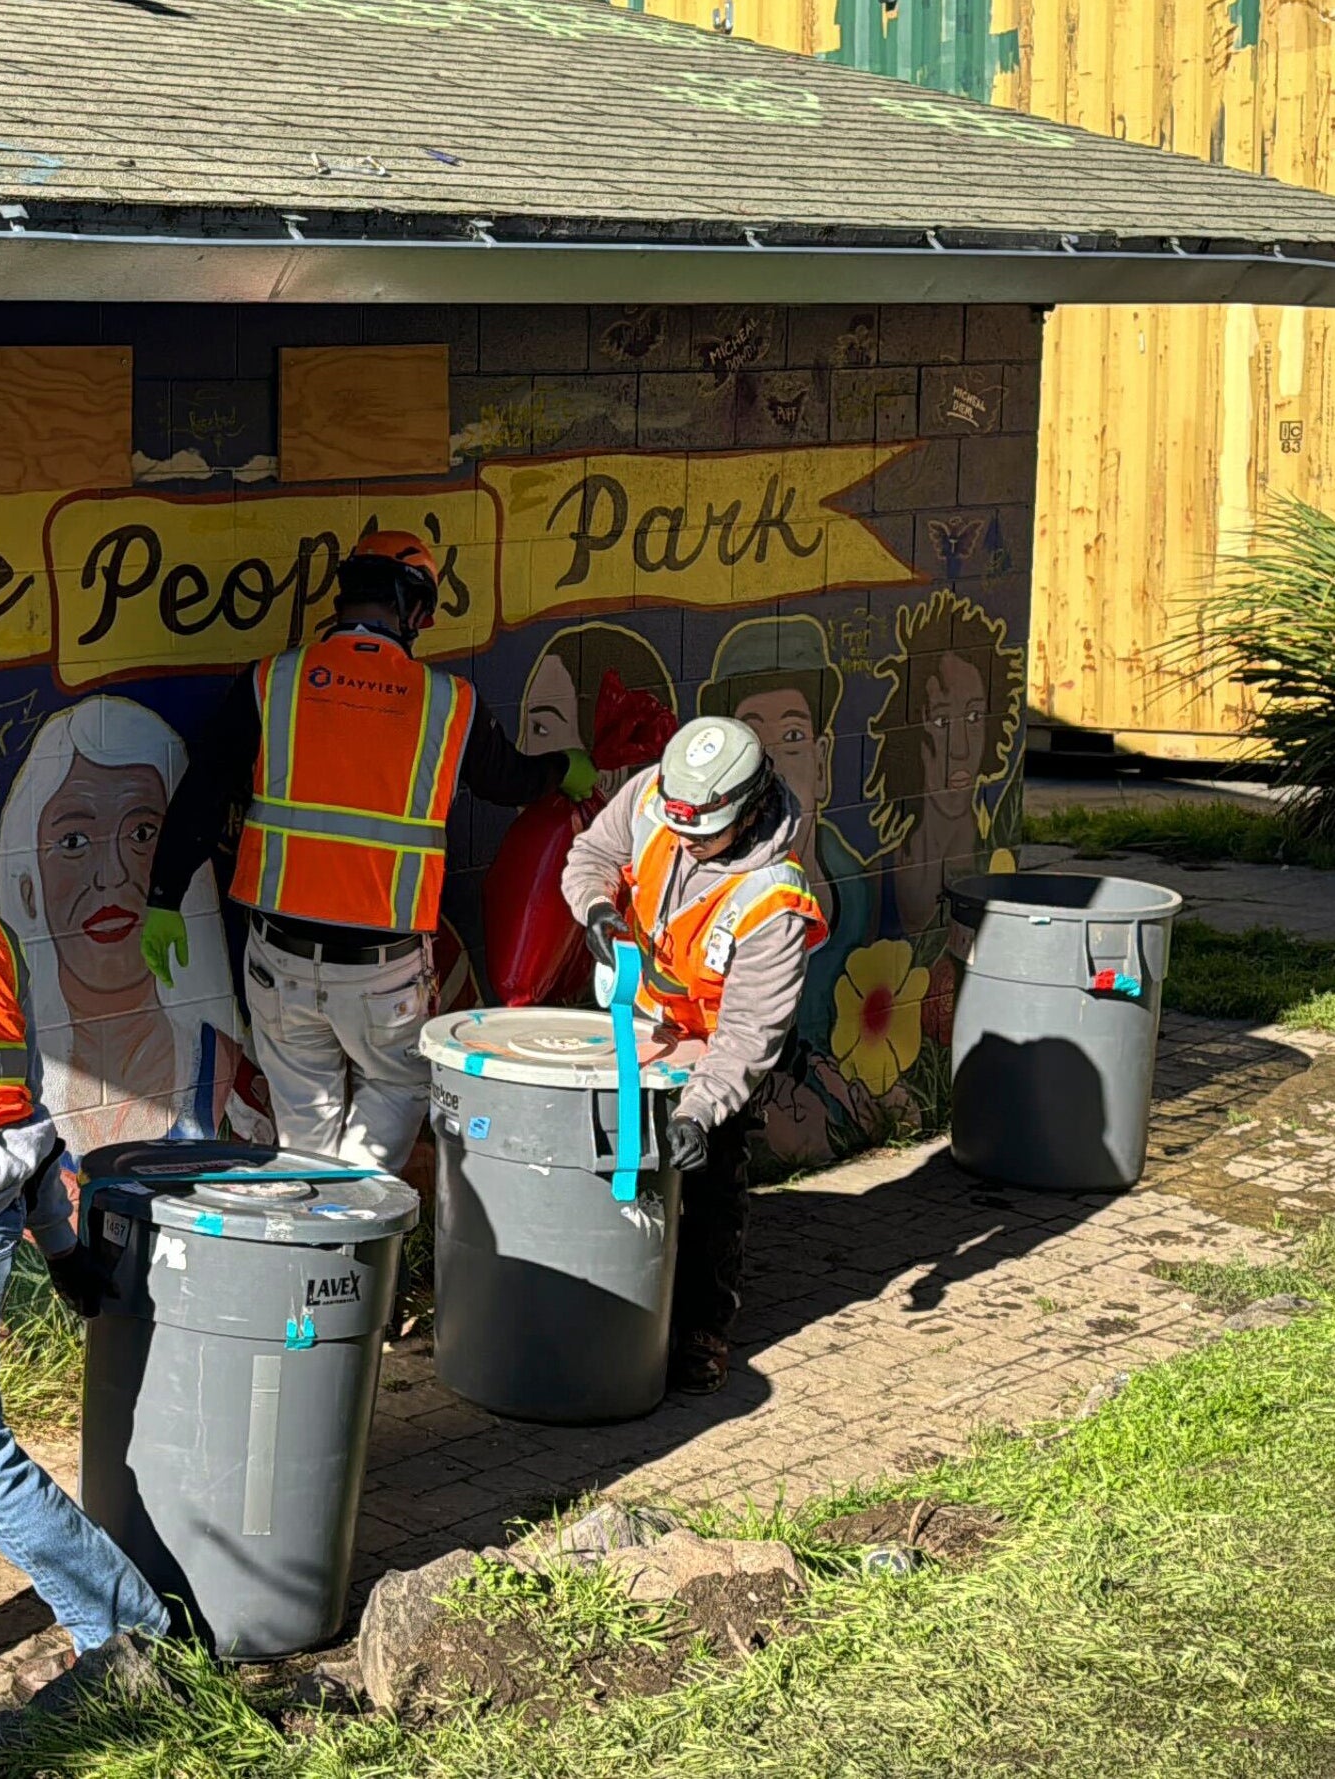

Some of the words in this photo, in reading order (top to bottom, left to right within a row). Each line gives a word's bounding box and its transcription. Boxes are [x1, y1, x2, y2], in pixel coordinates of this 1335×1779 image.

[1280, 440, 1303, 453] 83
[77, 511, 471, 646] Peop's
[546, 473, 824, 590] Park
[336, 675, 408, 695] BAYVIEW
[306, 1270, 361, 1306] LAVEX
